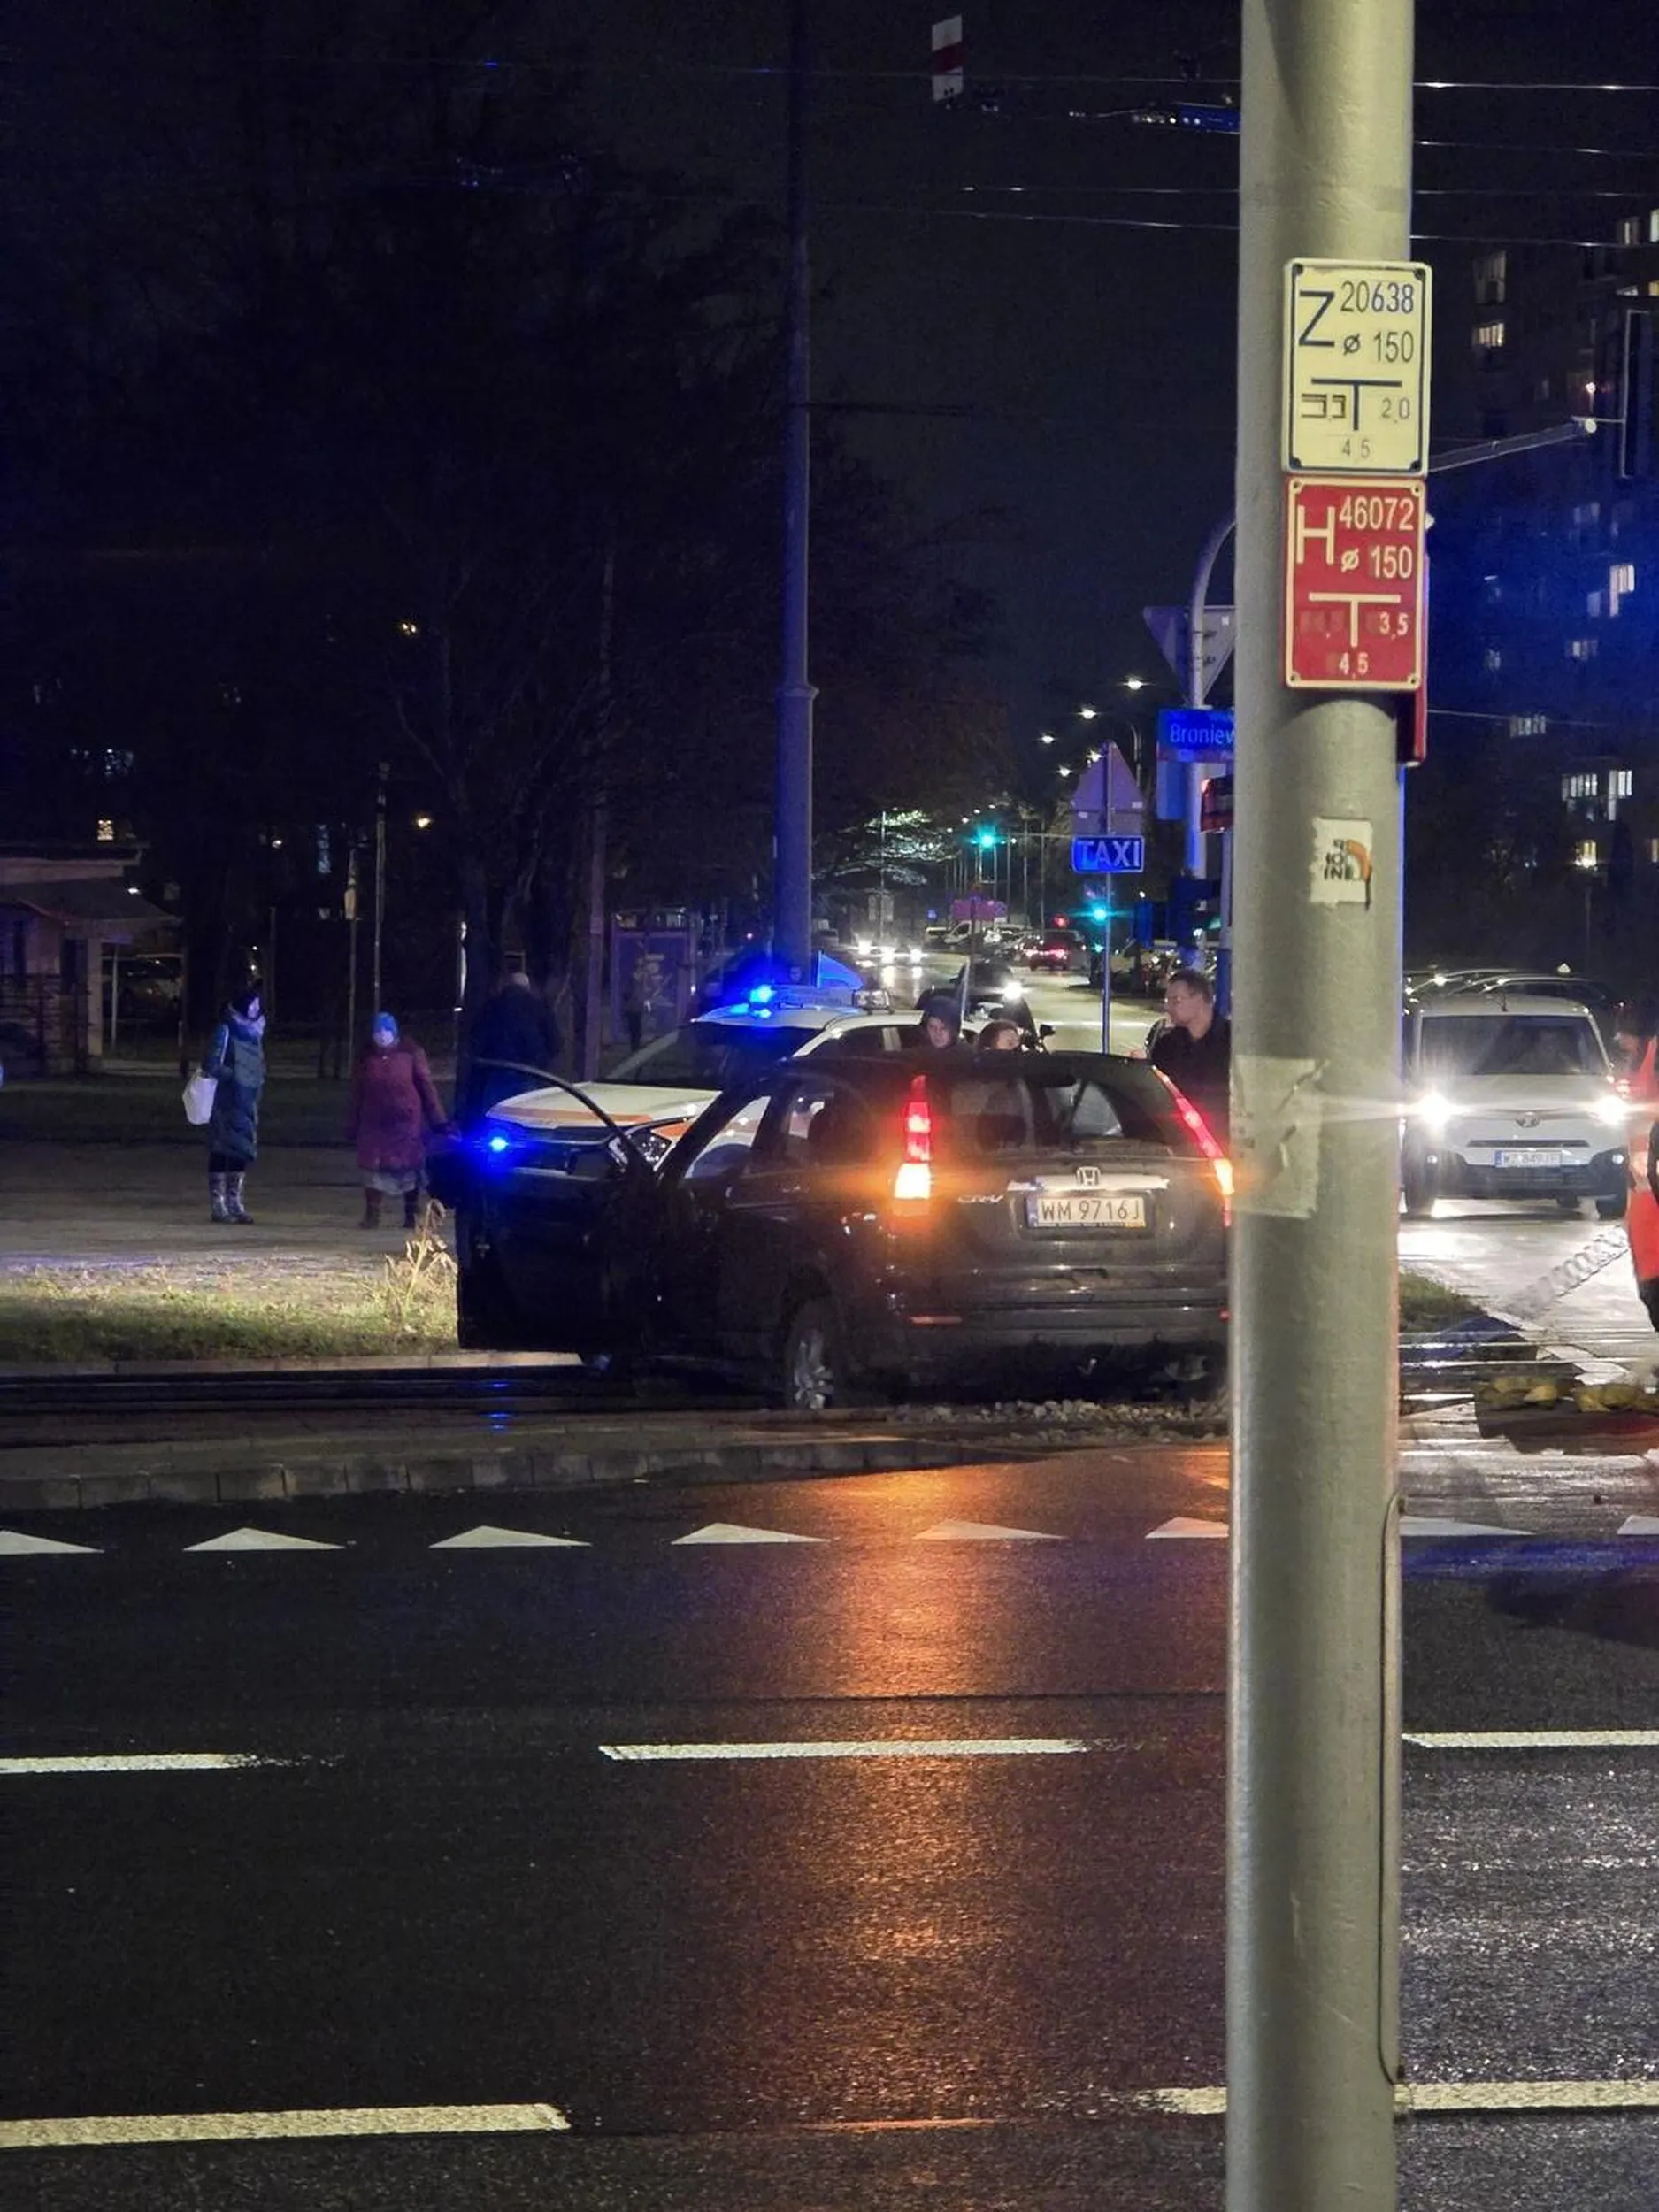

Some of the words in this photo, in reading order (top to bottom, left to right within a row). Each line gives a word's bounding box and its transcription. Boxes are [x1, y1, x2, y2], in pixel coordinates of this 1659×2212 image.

[1340, 280, 1415, 314] 20638
[1298, 289, 1336, 348] Z
[1373, 330, 1415, 364] 150
[1338, 495, 1415, 531] 46072
[1295, 504, 1336, 565] H
[1371, 545, 1414, 580] 150
[1077, 840, 1141, 868] TAXI
[1041, 1200, 1072, 1221] WM
[1078, 1199, 1141, 1221] 9716J
